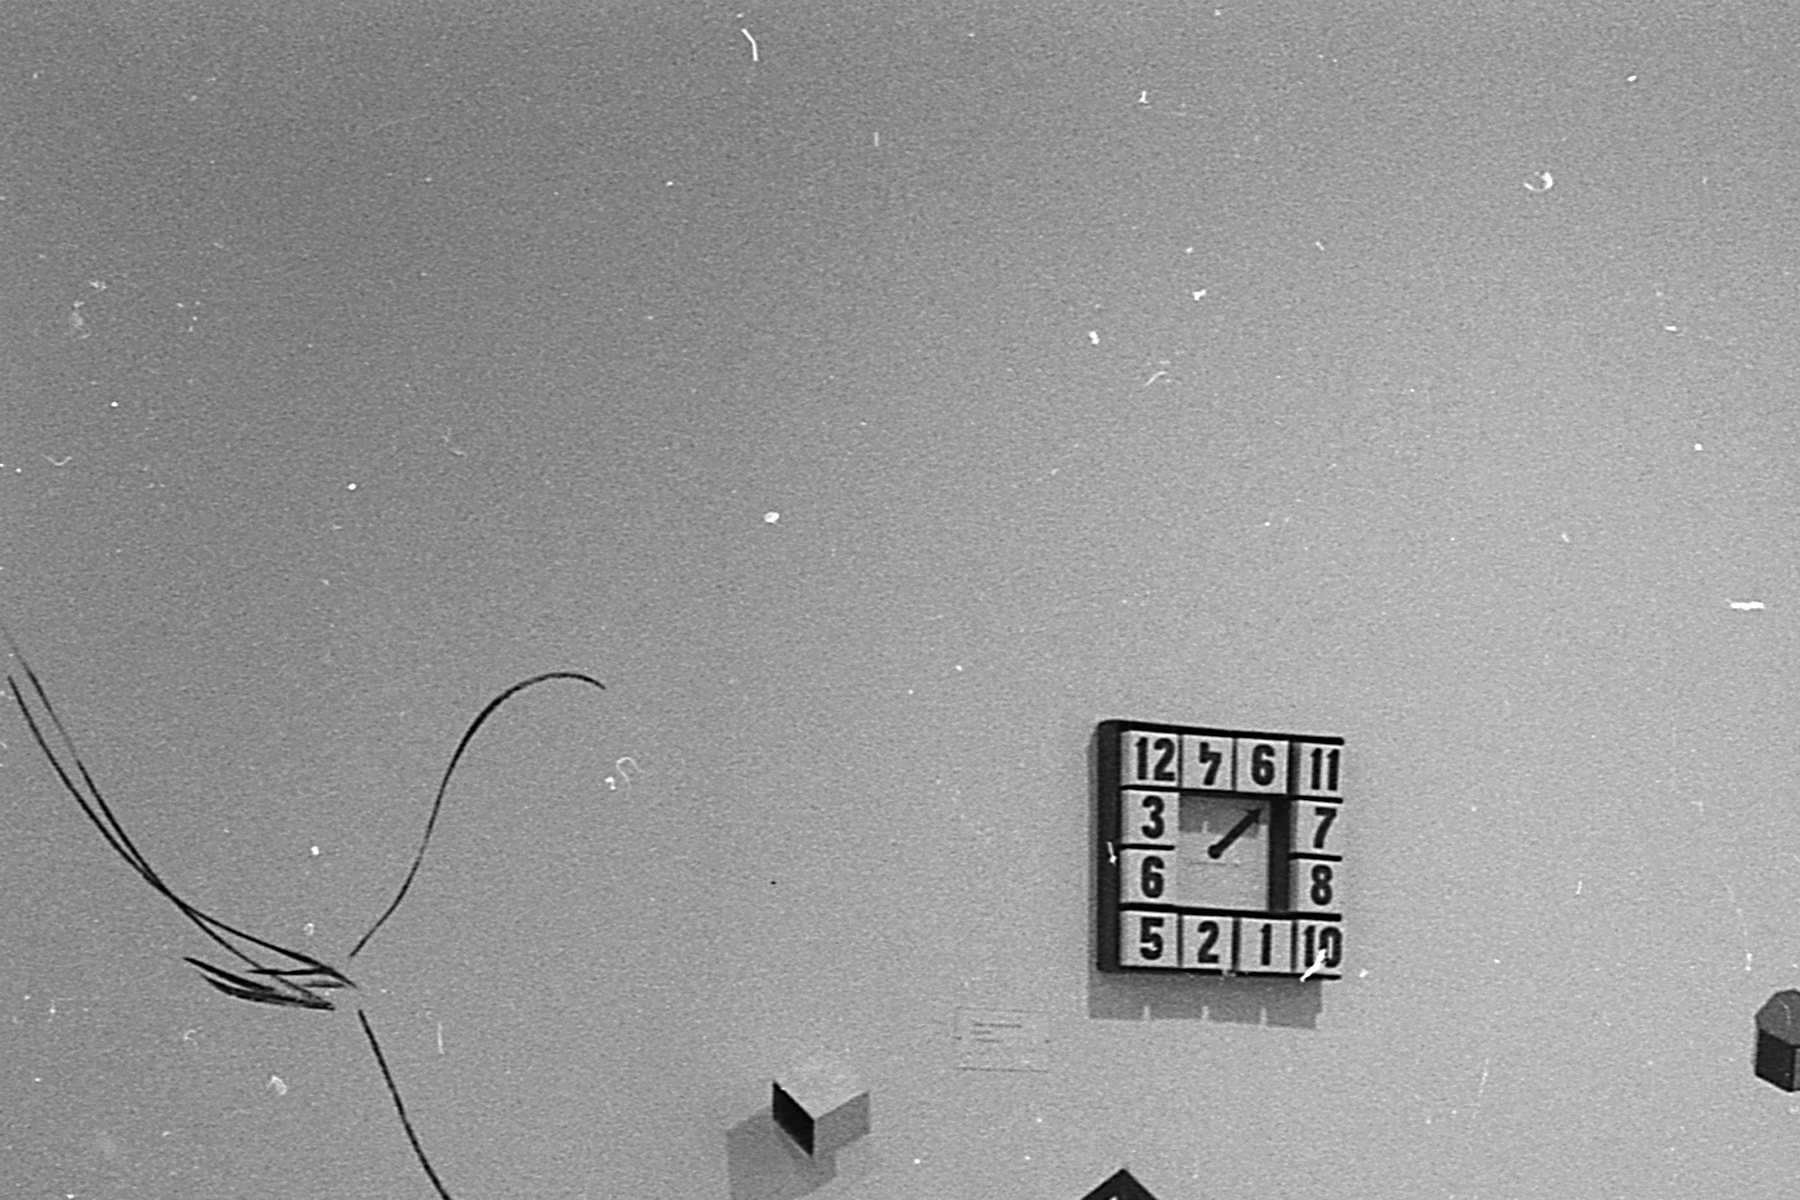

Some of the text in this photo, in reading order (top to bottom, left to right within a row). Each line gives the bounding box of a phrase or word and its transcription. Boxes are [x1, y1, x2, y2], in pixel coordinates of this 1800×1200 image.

[1136, 736, 1176, 782] 12
[1199, 741, 1223, 786] 4
[1311, 747, 1340, 792] 11
[1141, 795, 1338, 849] 3 7
[1141, 855, 1333, 906] 6 8
[1139, 916, 1343, 969] 5 2 1 10
